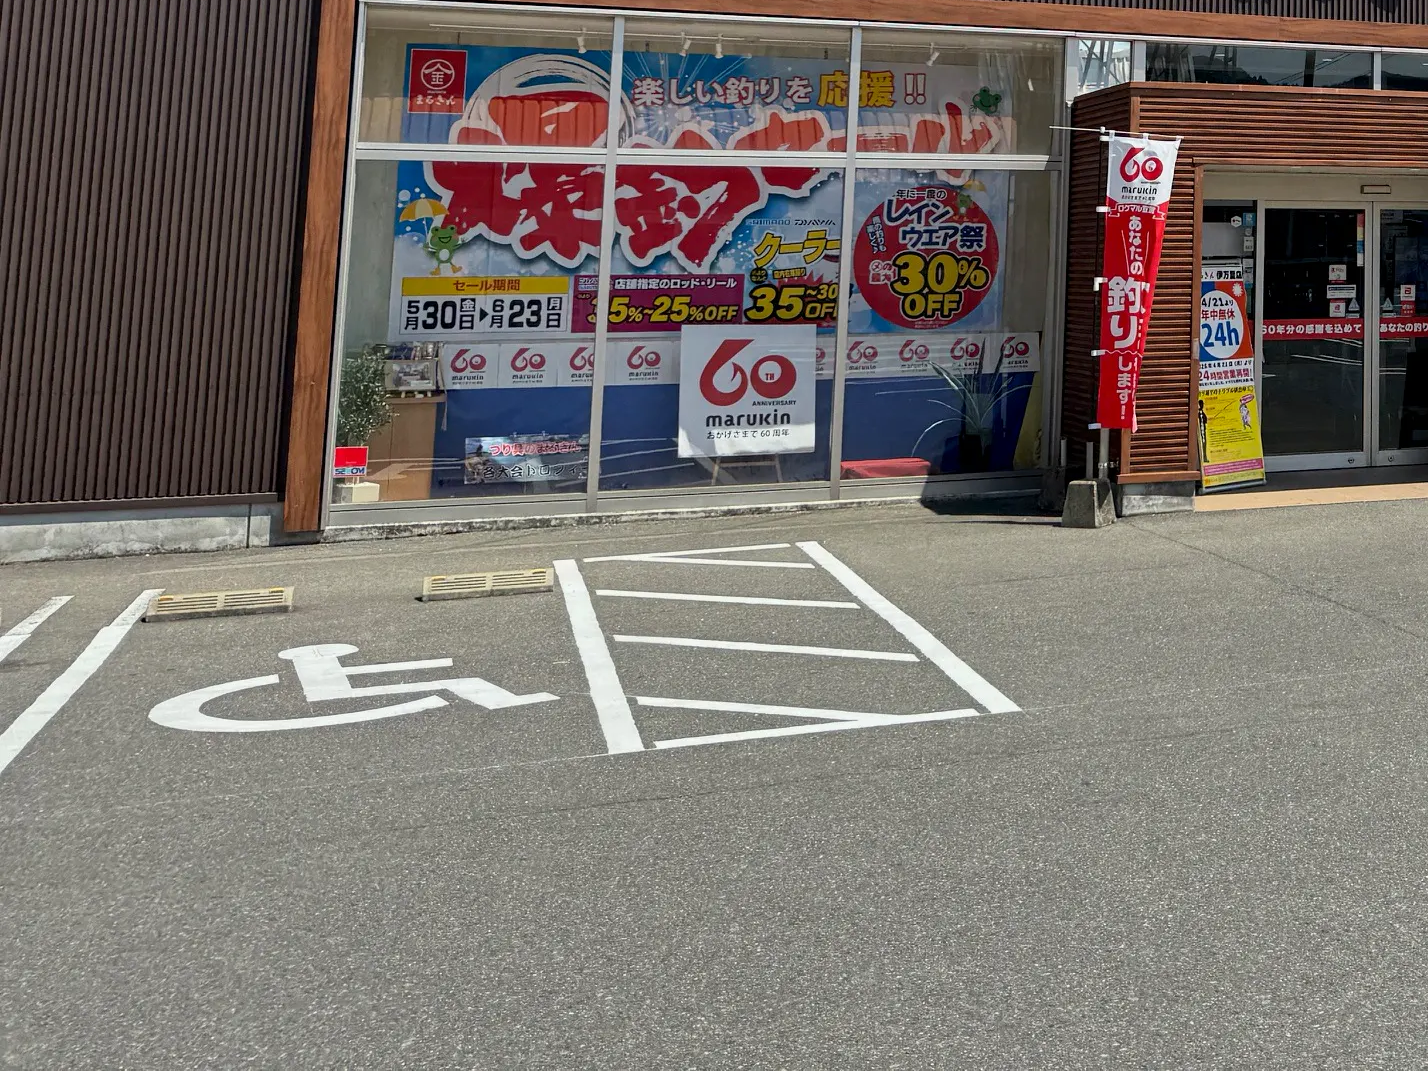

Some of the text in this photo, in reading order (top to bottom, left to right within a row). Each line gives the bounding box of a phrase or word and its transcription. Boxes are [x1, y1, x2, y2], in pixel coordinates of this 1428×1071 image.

[415, 93, 456, 106] まるきん
[1121, 186, 1158, 195] marukin
[886, 199, 952, 225] レイン
[892, 254, 988, 294] 30%
[453, 279, 521, 292] セール期間
[904, 294, 961, 317] OFF
[1201, 308, 1236, 321] 年中無休
[1201, 320, 1240, 347] 24h
[699, 339, 797, 406] 60
[706, 409, 791, 427] marukin
